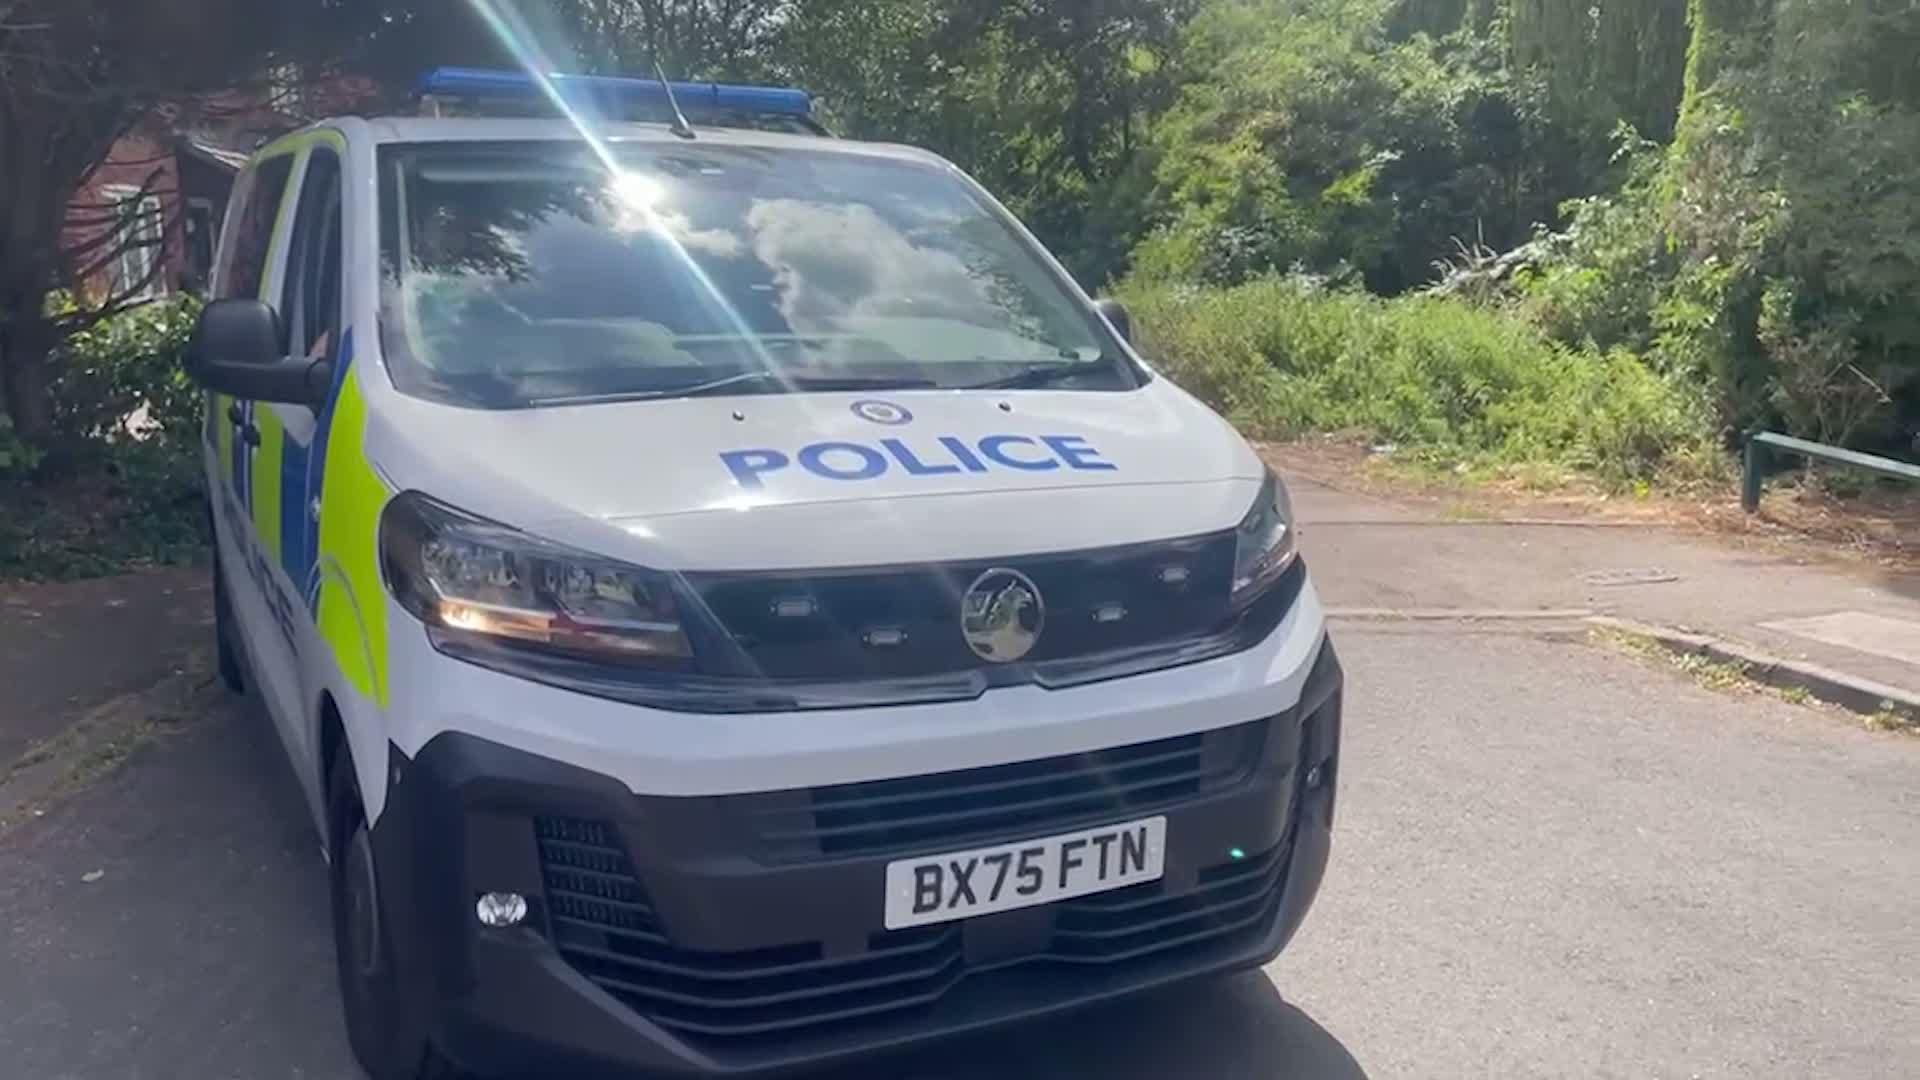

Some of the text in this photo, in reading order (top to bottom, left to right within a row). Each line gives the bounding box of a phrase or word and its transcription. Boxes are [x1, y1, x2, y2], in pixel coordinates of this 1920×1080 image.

[718, 435, 1119, 490] POLICE
[912, 826, 1147, 915] BX75 FTN
